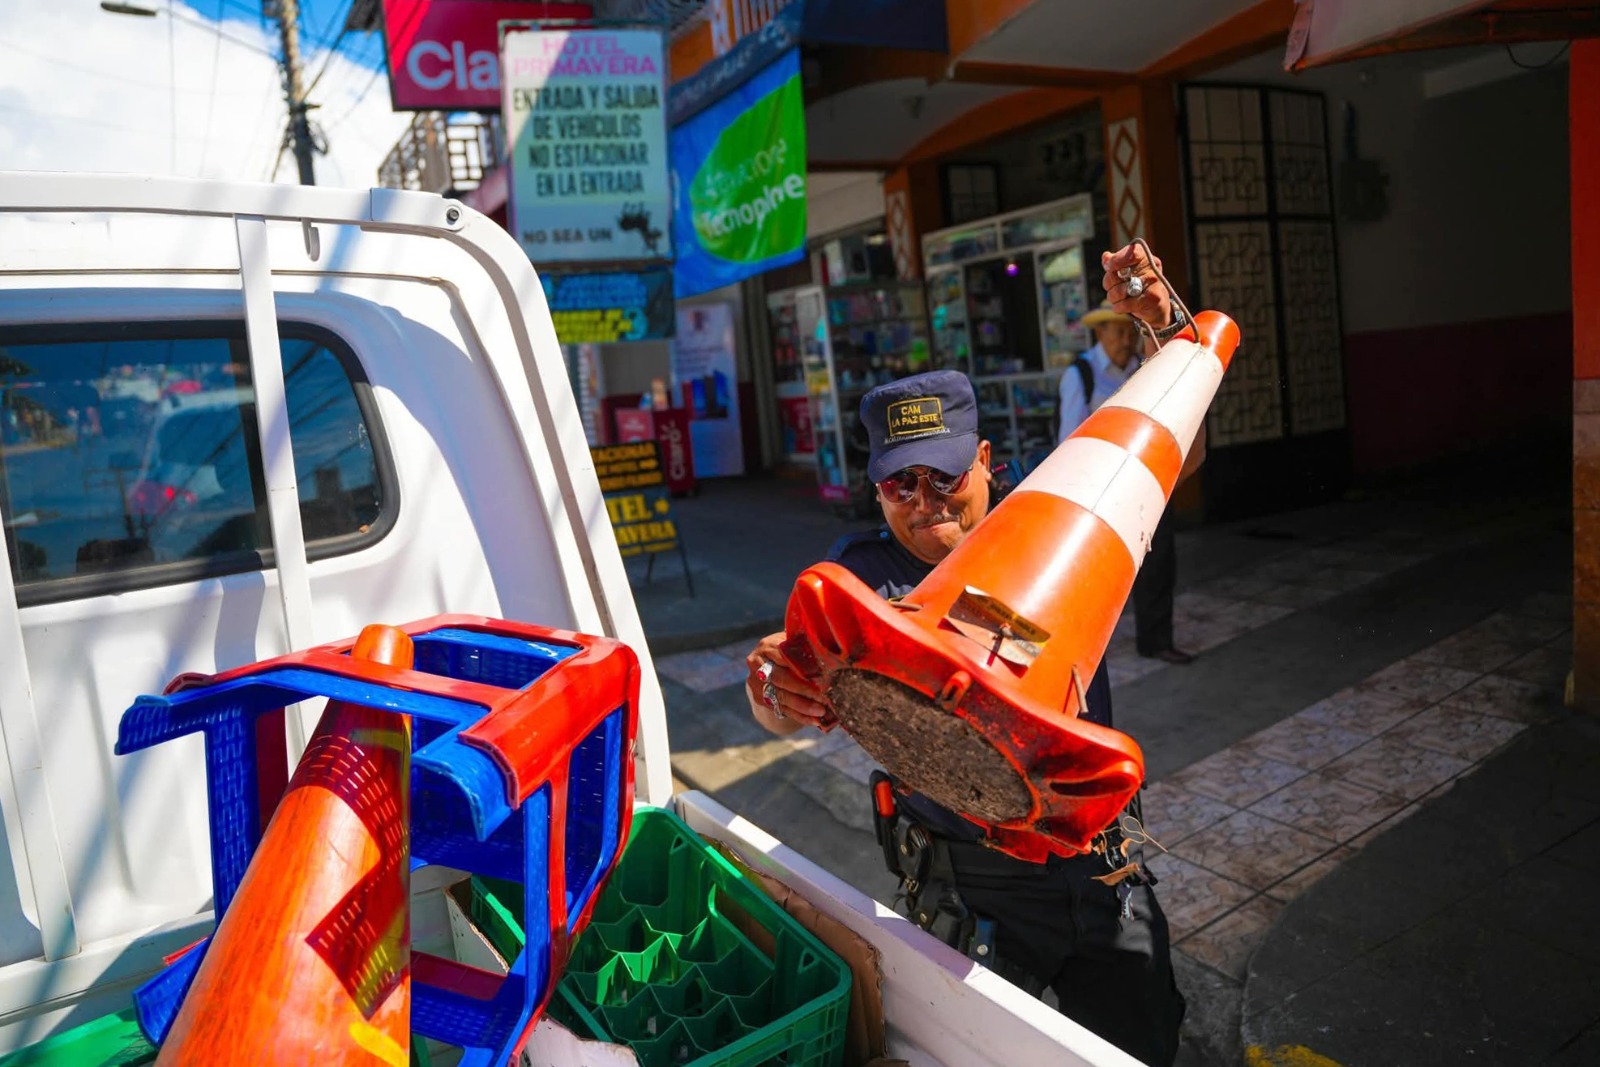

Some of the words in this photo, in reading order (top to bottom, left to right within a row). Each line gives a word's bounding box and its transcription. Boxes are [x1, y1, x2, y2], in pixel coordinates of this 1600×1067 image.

[542, 36, 625, 54] HOTEL
[406, 39, 499, 90] Cla
[513, 55, 657, 76] PRIMAVERA
[513, 84, 585, 111] ENTRADA
[588, 83, 599, 109] Y
[604, 82, 660, 110] SALIDA
[533, 115, 552, 139] DE
[529, 145, 549, 168] NO
[554, 142, 649, 167] ESTACIONAR
[536, 172, 554, 197] EN
[558, 172, 577, 196] LA
[581, 170, 644, 195] ENTRADA
[522, 230, 548, 244] NO
[552, 229, 584, 243] SEA
[588, 228, 612, 242] UN
[891, 418, 901, 428] LA
[901, 415, 918, 426] PAZ
[919, 413, 939, 423] ESTE
[901, 405, 921, 416] CAM
[604, 495, 653, 524] TEL
[613, 521, 677, 545] AVERA
